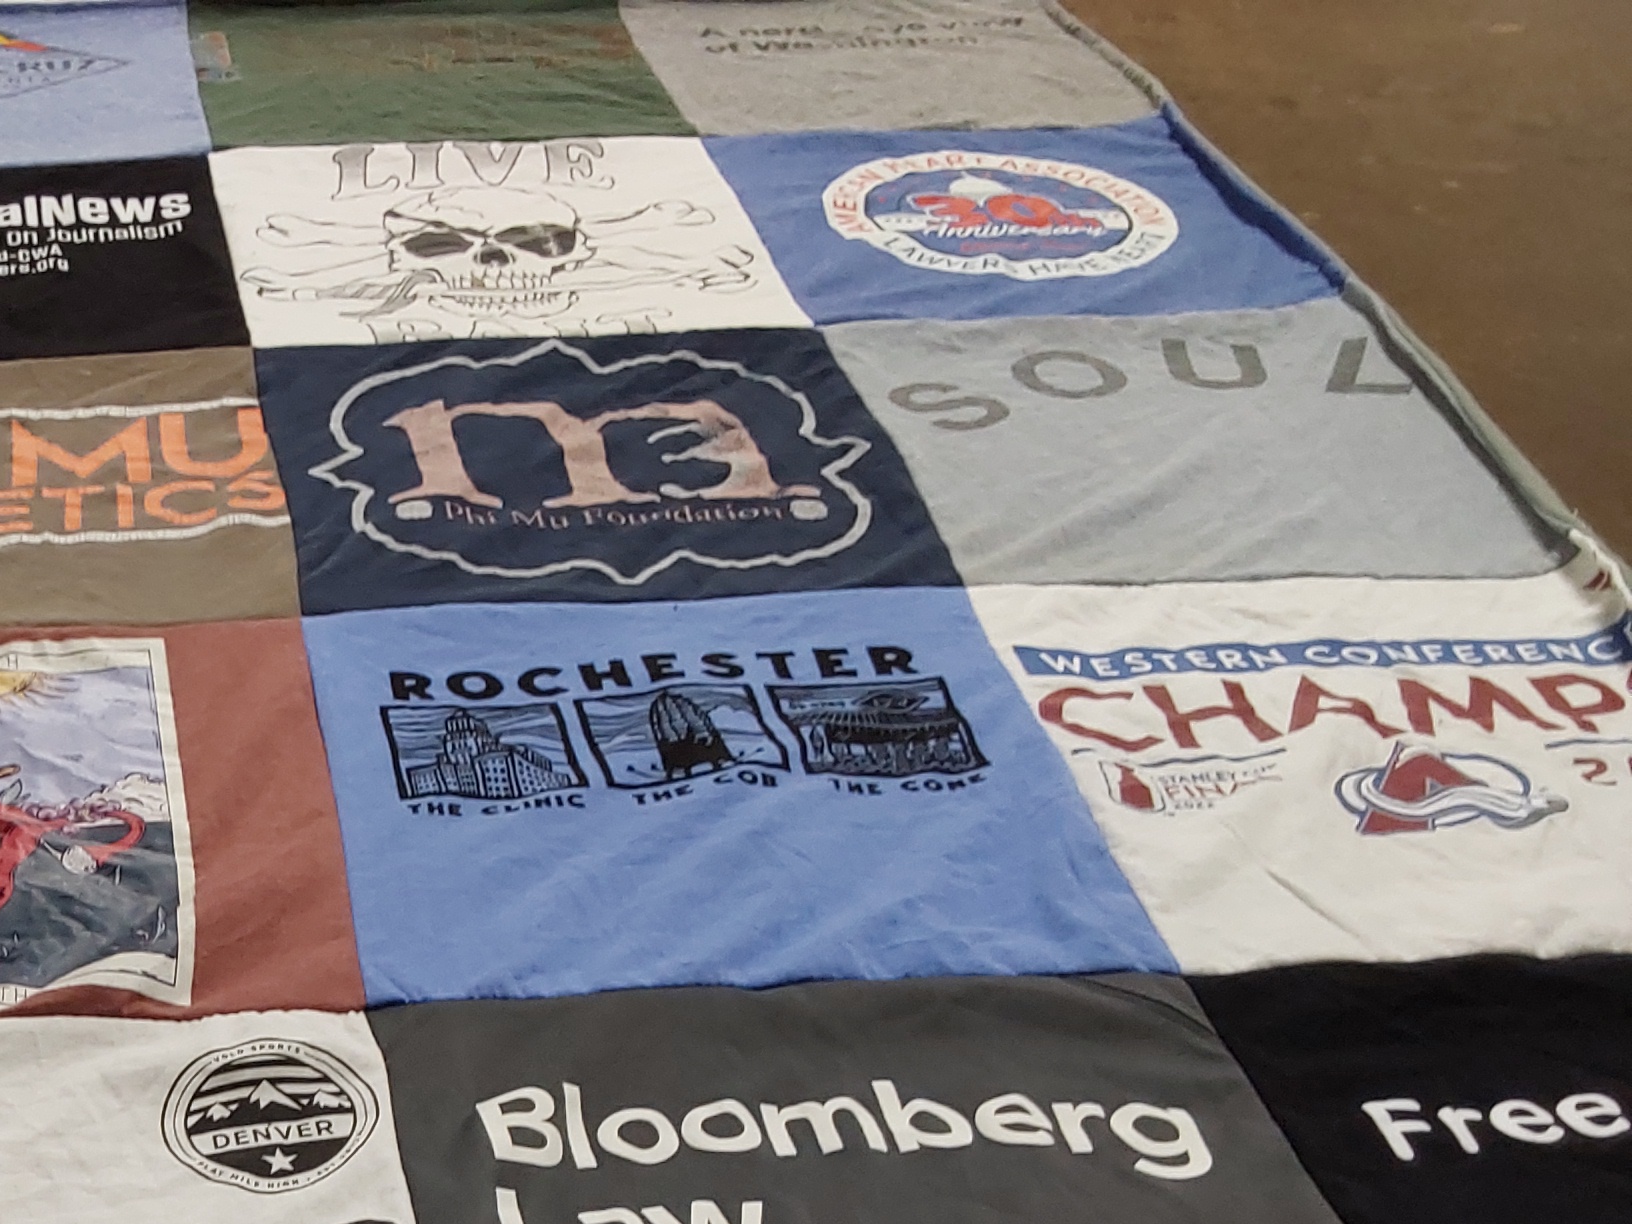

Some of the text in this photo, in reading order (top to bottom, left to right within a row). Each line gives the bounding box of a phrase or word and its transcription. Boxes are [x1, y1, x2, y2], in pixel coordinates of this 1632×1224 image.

[331, 142, 615, 201] LIVE
[6, 230, 39, 247] On
[46, 219, 184, 246] Journalism
[887, 336, 1414, 431] SOUL
[11, 407, 269, 488] MU
[443, 500, 786, 530] Phi Mu Foundation
[388, 644, 920, 702] ROCHESTER
[1039, 622, 1632, 679] WESTERN CONFERENC
[1037, 673, 1632, 752] CHAMP
[406, 793, 587, 817] THE CLINIC
[631, 785, 694, 806] THE
[250, 1043, 301, 1055] SPORTS
[211, 1119, 334, 1150] DENVER
[475, 1079, 1213, 1181] Bloomberg
[1360, 1092, 1632, 1162] Free
[196, 1160, 224, 1177] PLAY
